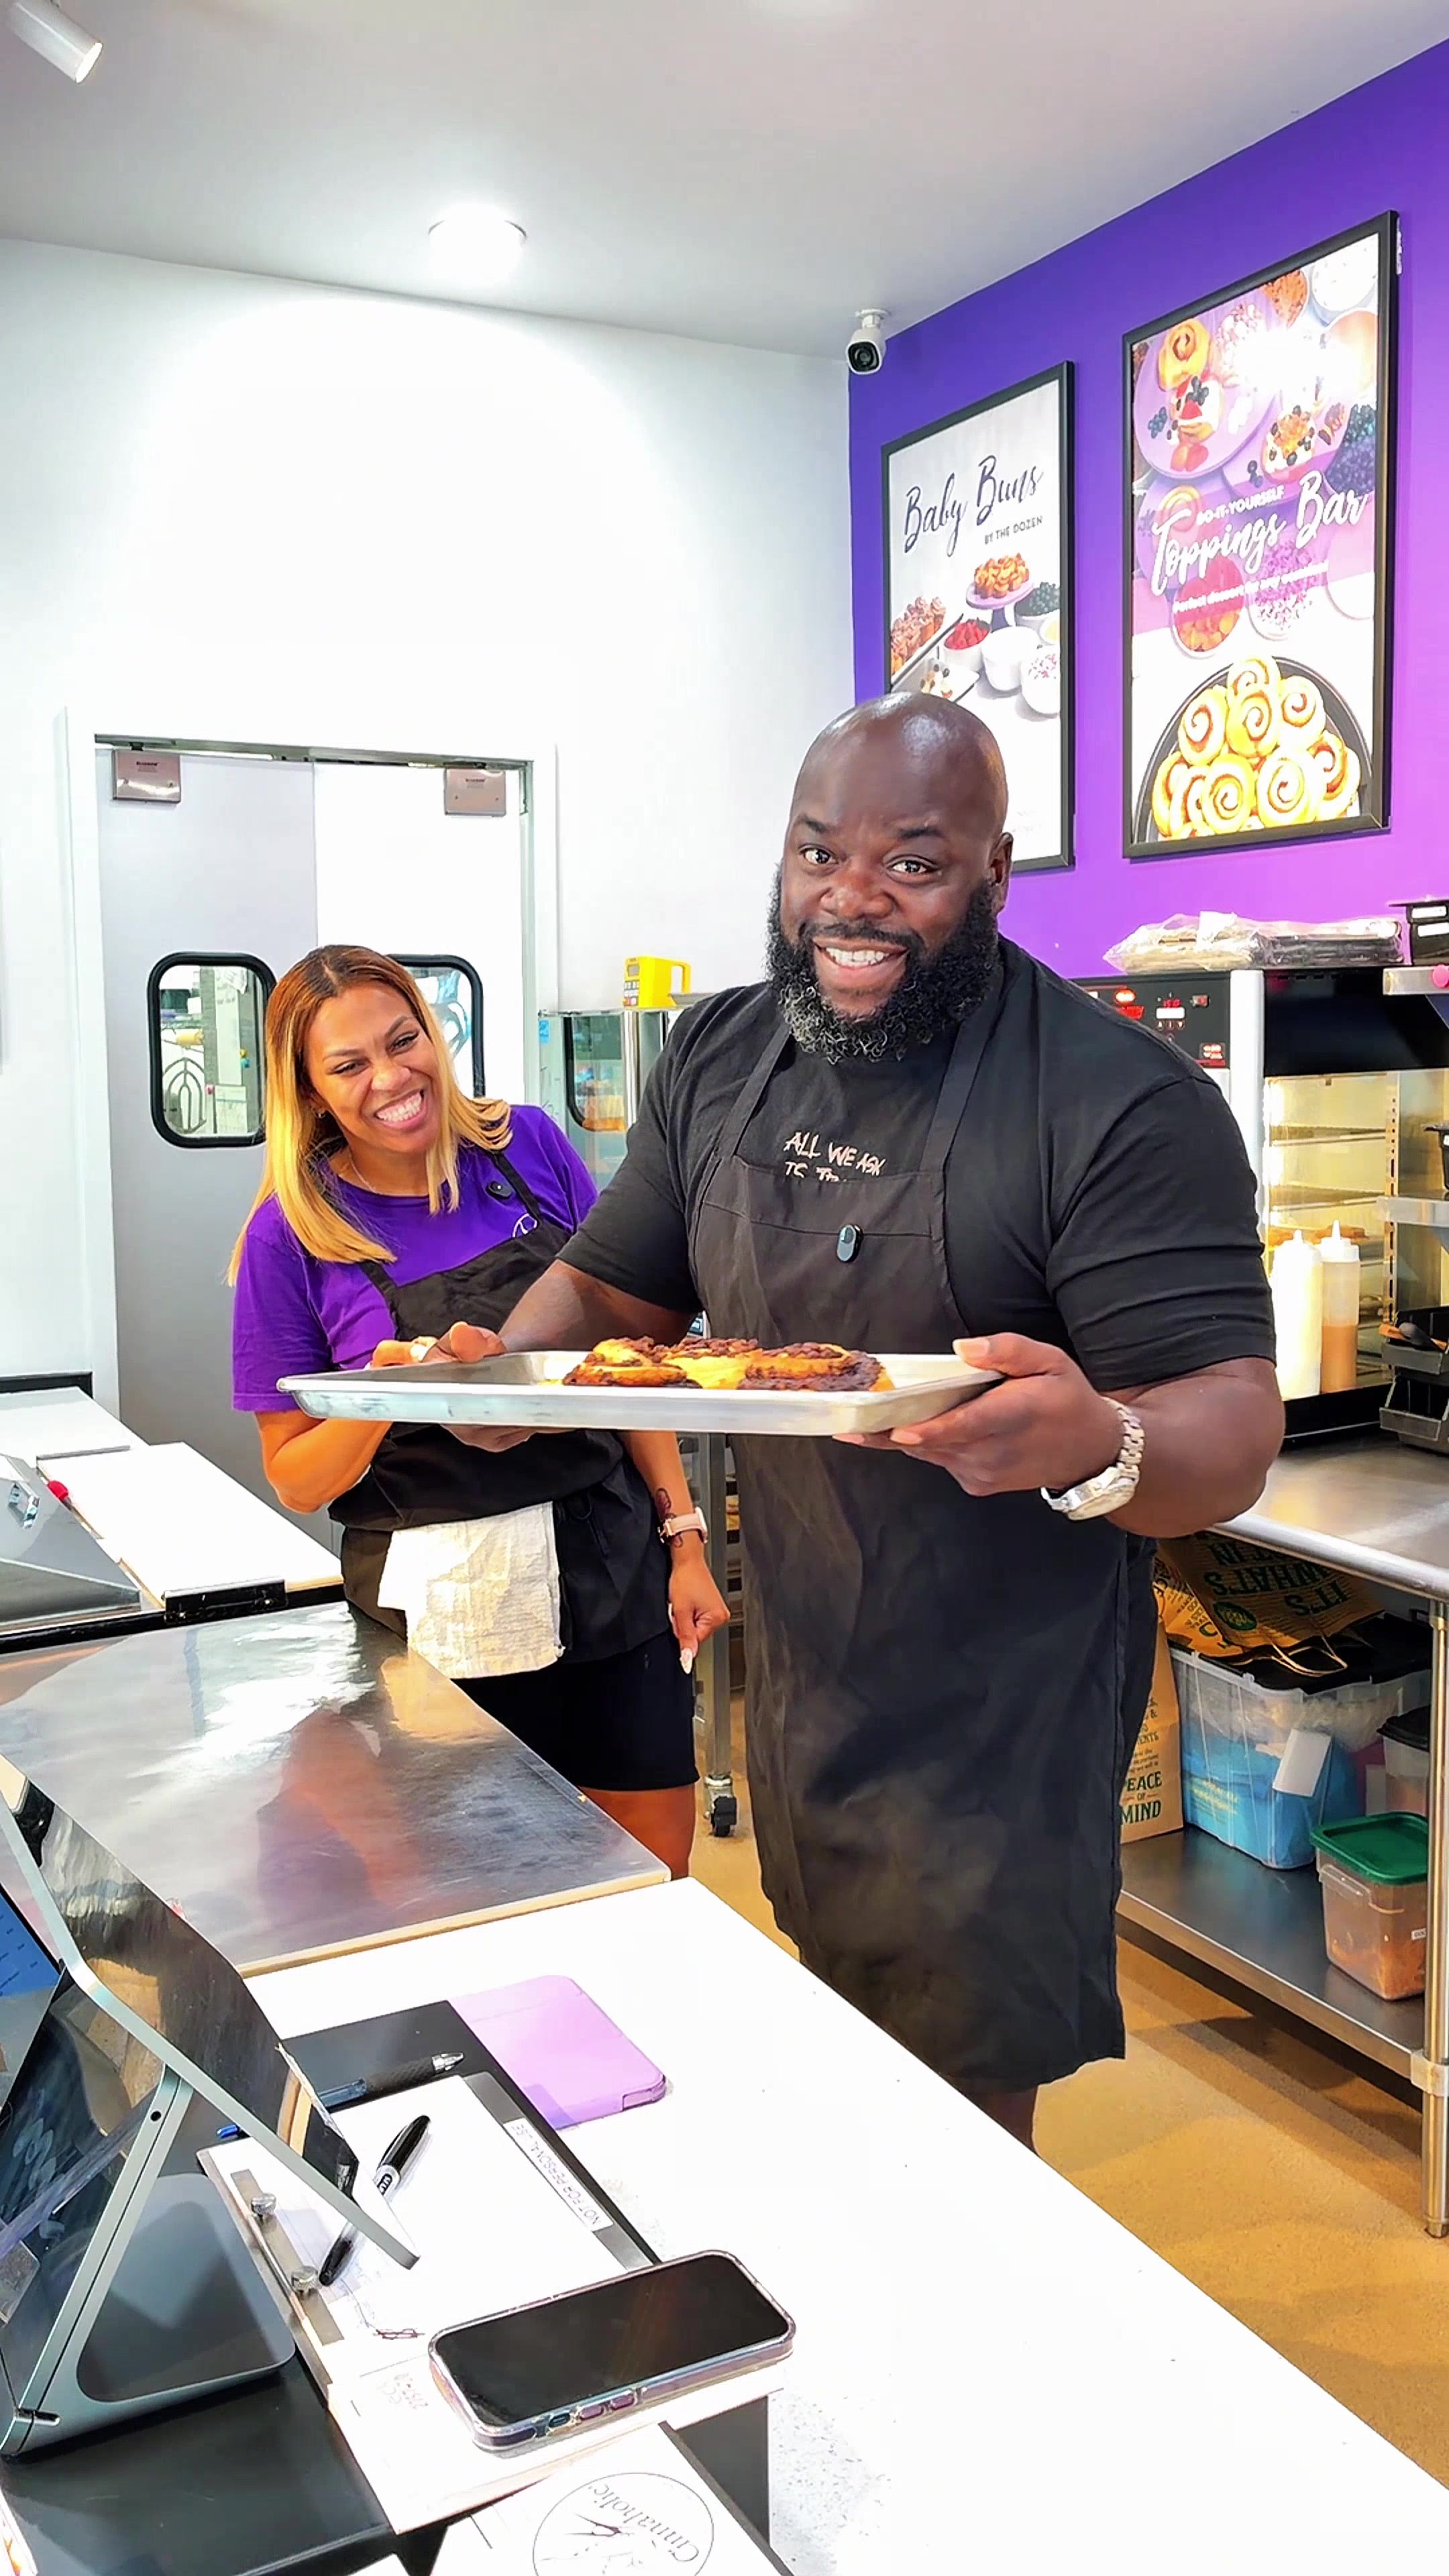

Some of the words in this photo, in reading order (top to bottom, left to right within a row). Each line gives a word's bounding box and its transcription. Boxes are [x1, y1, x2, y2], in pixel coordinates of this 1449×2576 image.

[904, 472, 969, 557] Baby
[977, 455, 1044, 526] Buns
[1197, 484, 1285, 526] DO-IT-YOURSELF
[984, 533, 994, 545] BY
[996, 526, 1010, 539] THE
[1013, 515, 1043, 534] DOZEN
[1151, 508, 1287, 596] Toppings
[1295, 470, 1369, 549] Bar
[784, 1131, 821, 1159] ALL
[828, 1142, 858, 1167] WE
[855, 1153, 886, 1176] ASK
[1204, 1562, 1331, 1595] WHAT'S
[1283, 1578, 1352, 1616] IT'S
[1124, 1770, 1163, 1792] EACE
[1120, 1799, 1161, 1824] MIND
[594, 2483, 700, 2562] Cinnaholic
